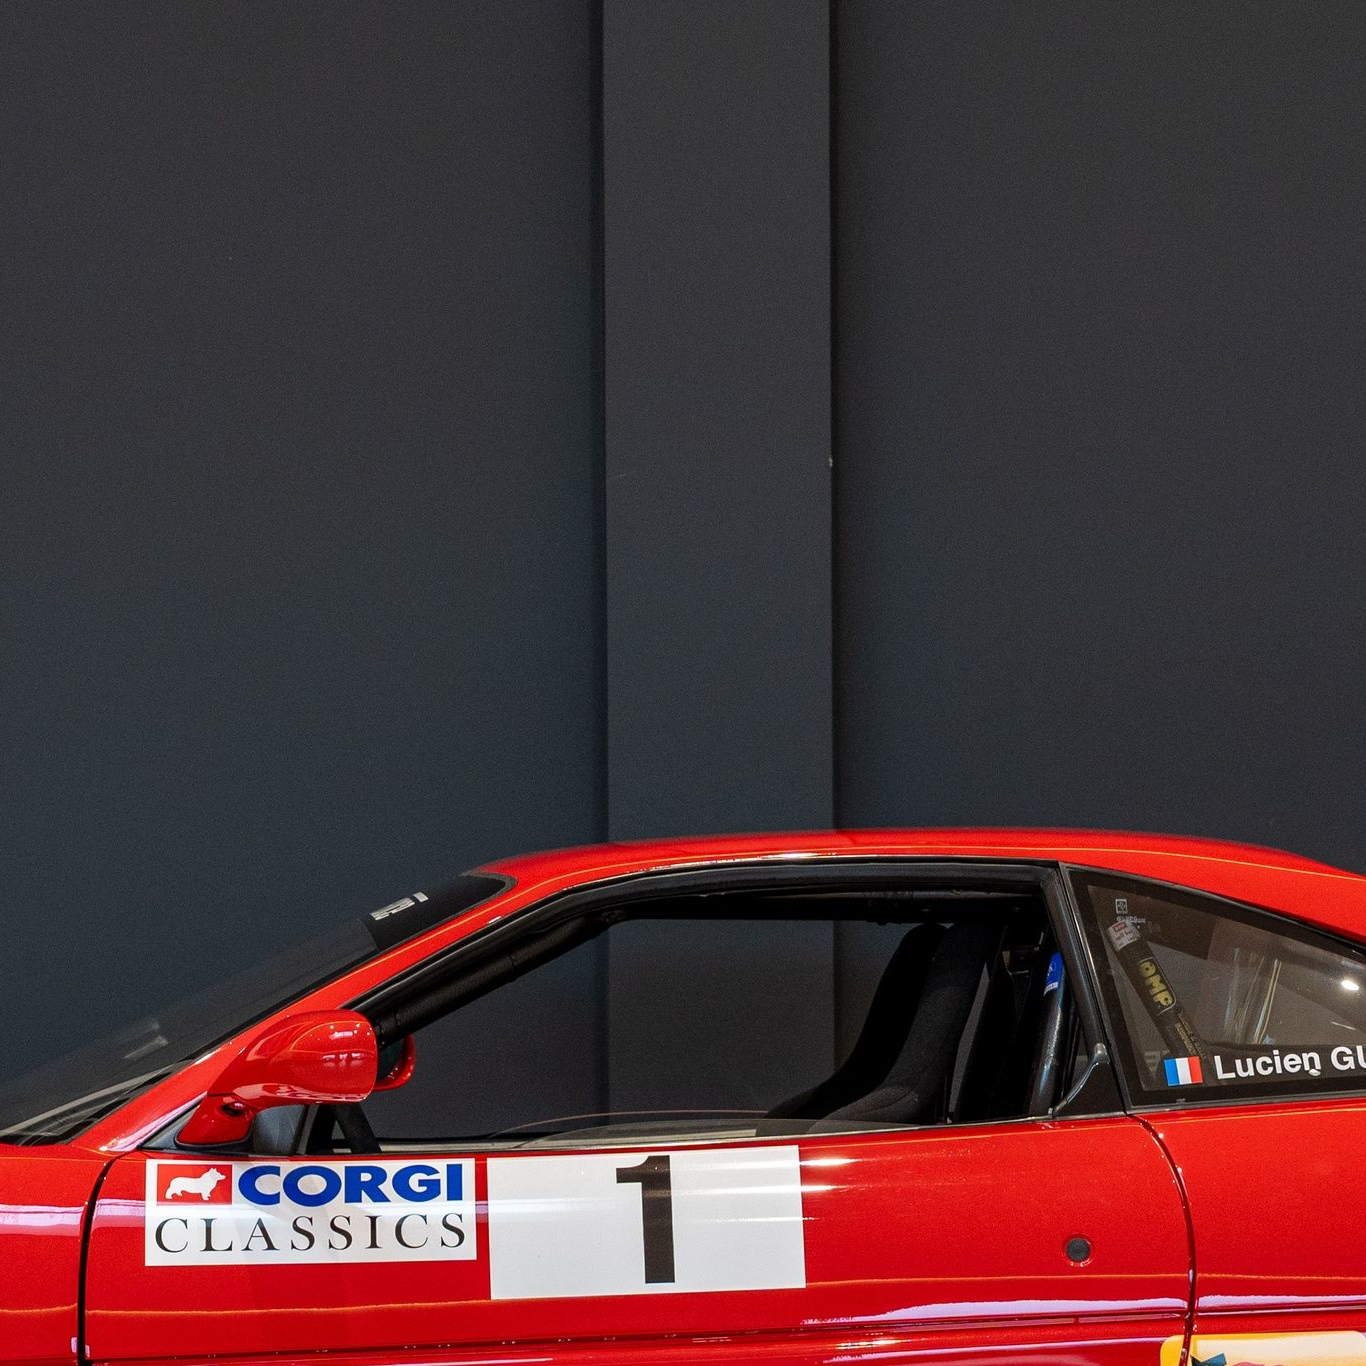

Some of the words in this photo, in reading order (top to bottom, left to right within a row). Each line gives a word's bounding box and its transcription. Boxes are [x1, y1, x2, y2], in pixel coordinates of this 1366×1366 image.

[1138, 960, 1174, 1007] OMP
[1214, 1049, 1321, 1080] Lucien
[237, 1163, 463, 1208] CORGI
[154, 1212, 467, 1253] CLASSICS
[615, 1155, 676, 1284] 1
